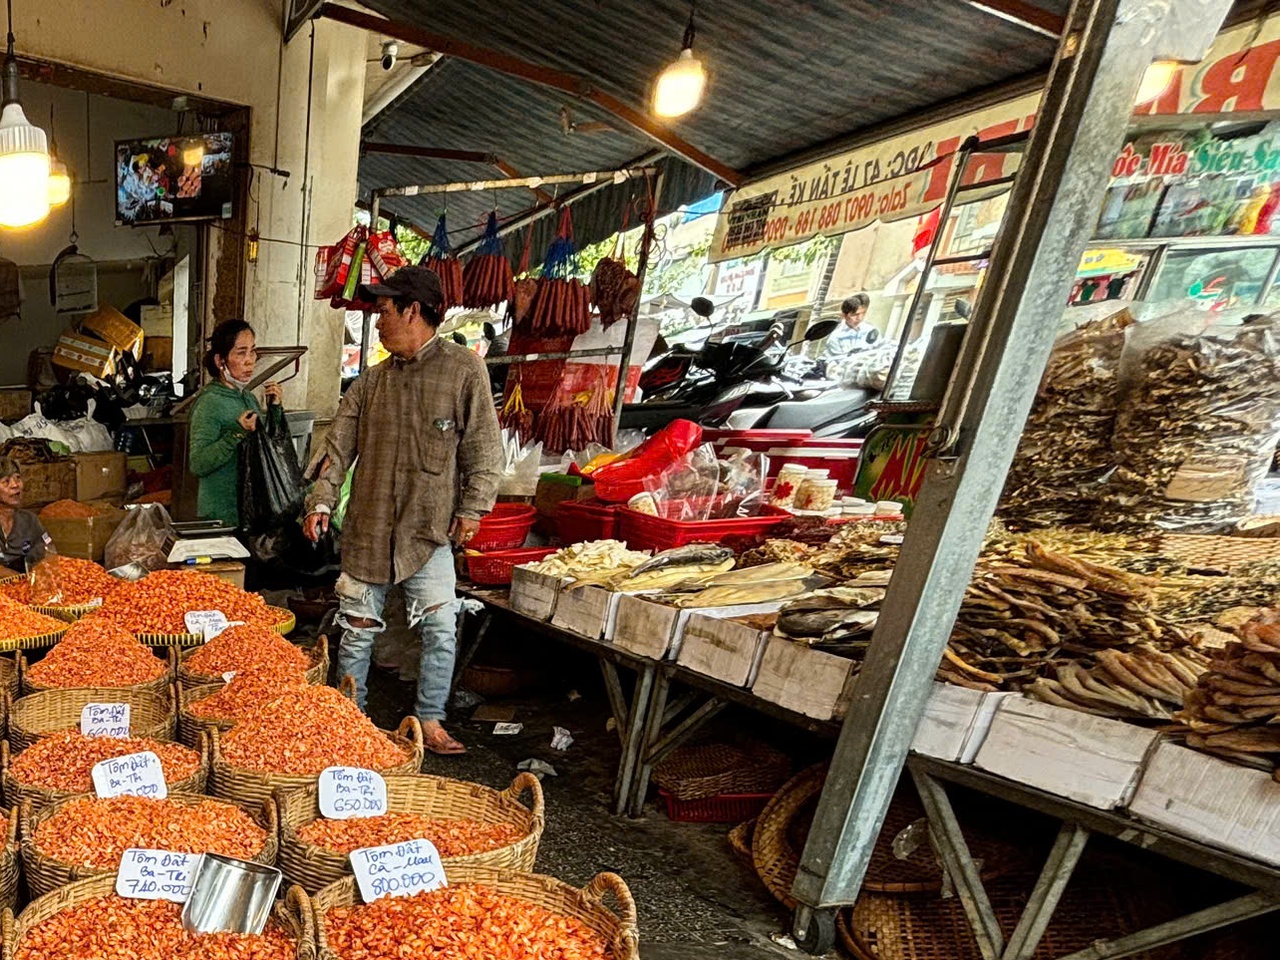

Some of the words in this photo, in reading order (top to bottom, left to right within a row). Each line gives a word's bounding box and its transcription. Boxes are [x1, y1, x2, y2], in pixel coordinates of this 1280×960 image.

[100, 759, 129, 774] Tôm
[327, 769, 353, 781] Tôm
[128, 850, 158, 864] Tôm
[161, 853, 190, 867] Đất
[358, 848, 394, 863] Tôm
[395, 841, 423, 858] Đất
